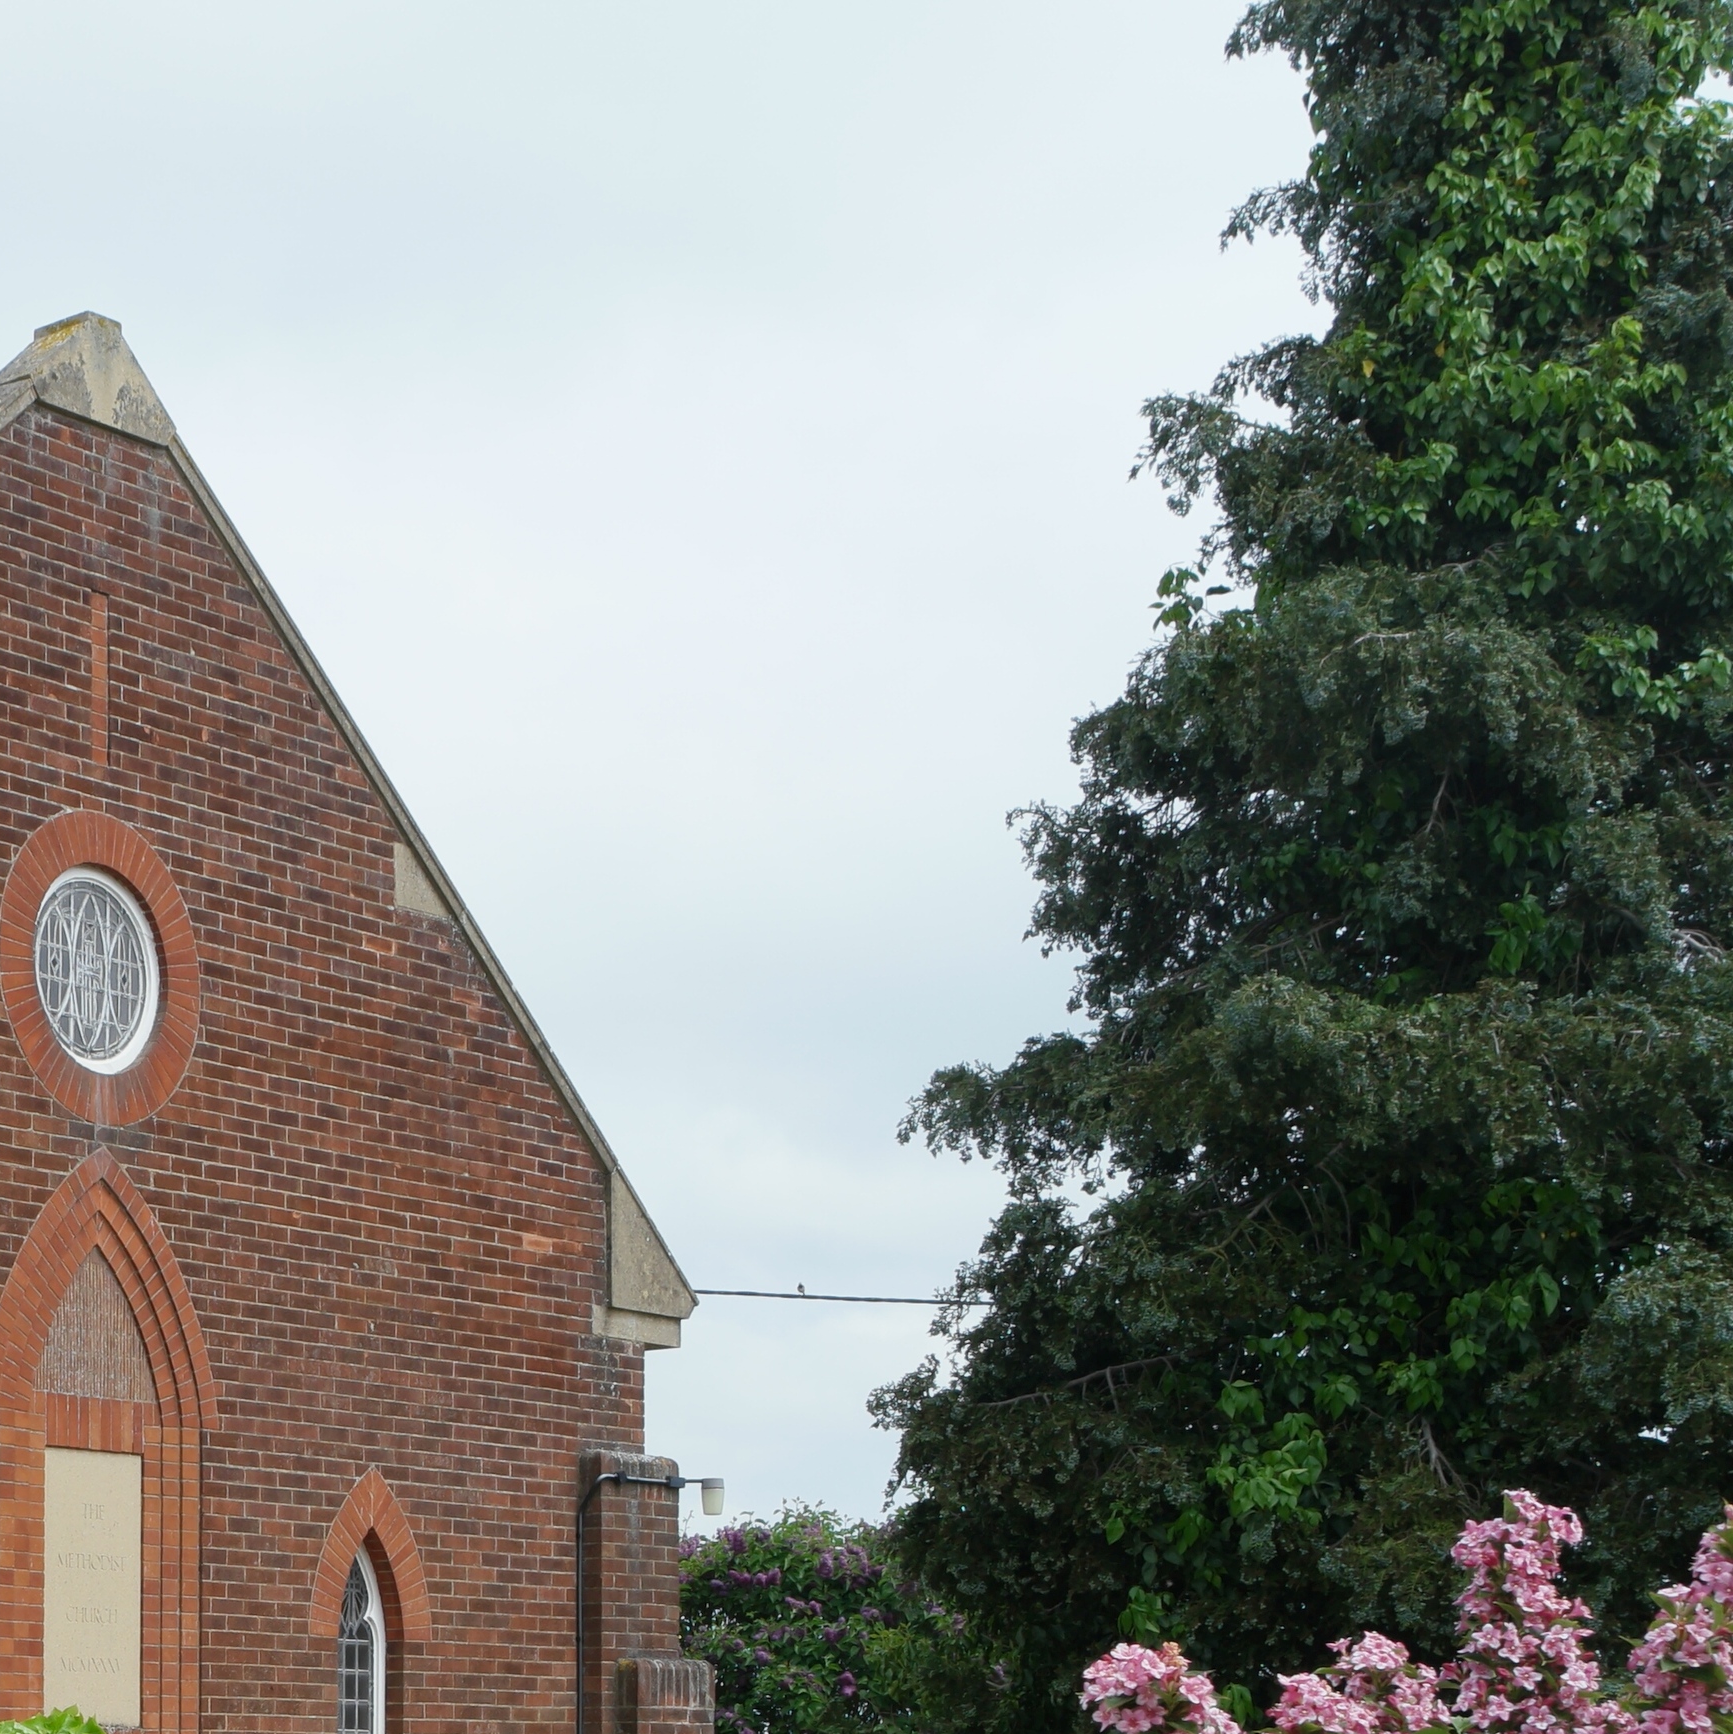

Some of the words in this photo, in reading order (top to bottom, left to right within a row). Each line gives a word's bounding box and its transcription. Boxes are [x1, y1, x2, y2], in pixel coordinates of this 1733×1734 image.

[82, 1503, 105, 1520] THE
[57, 1552, 127, 1572] METHODIST
[65, 1606, 118, 1624] CHURCH
